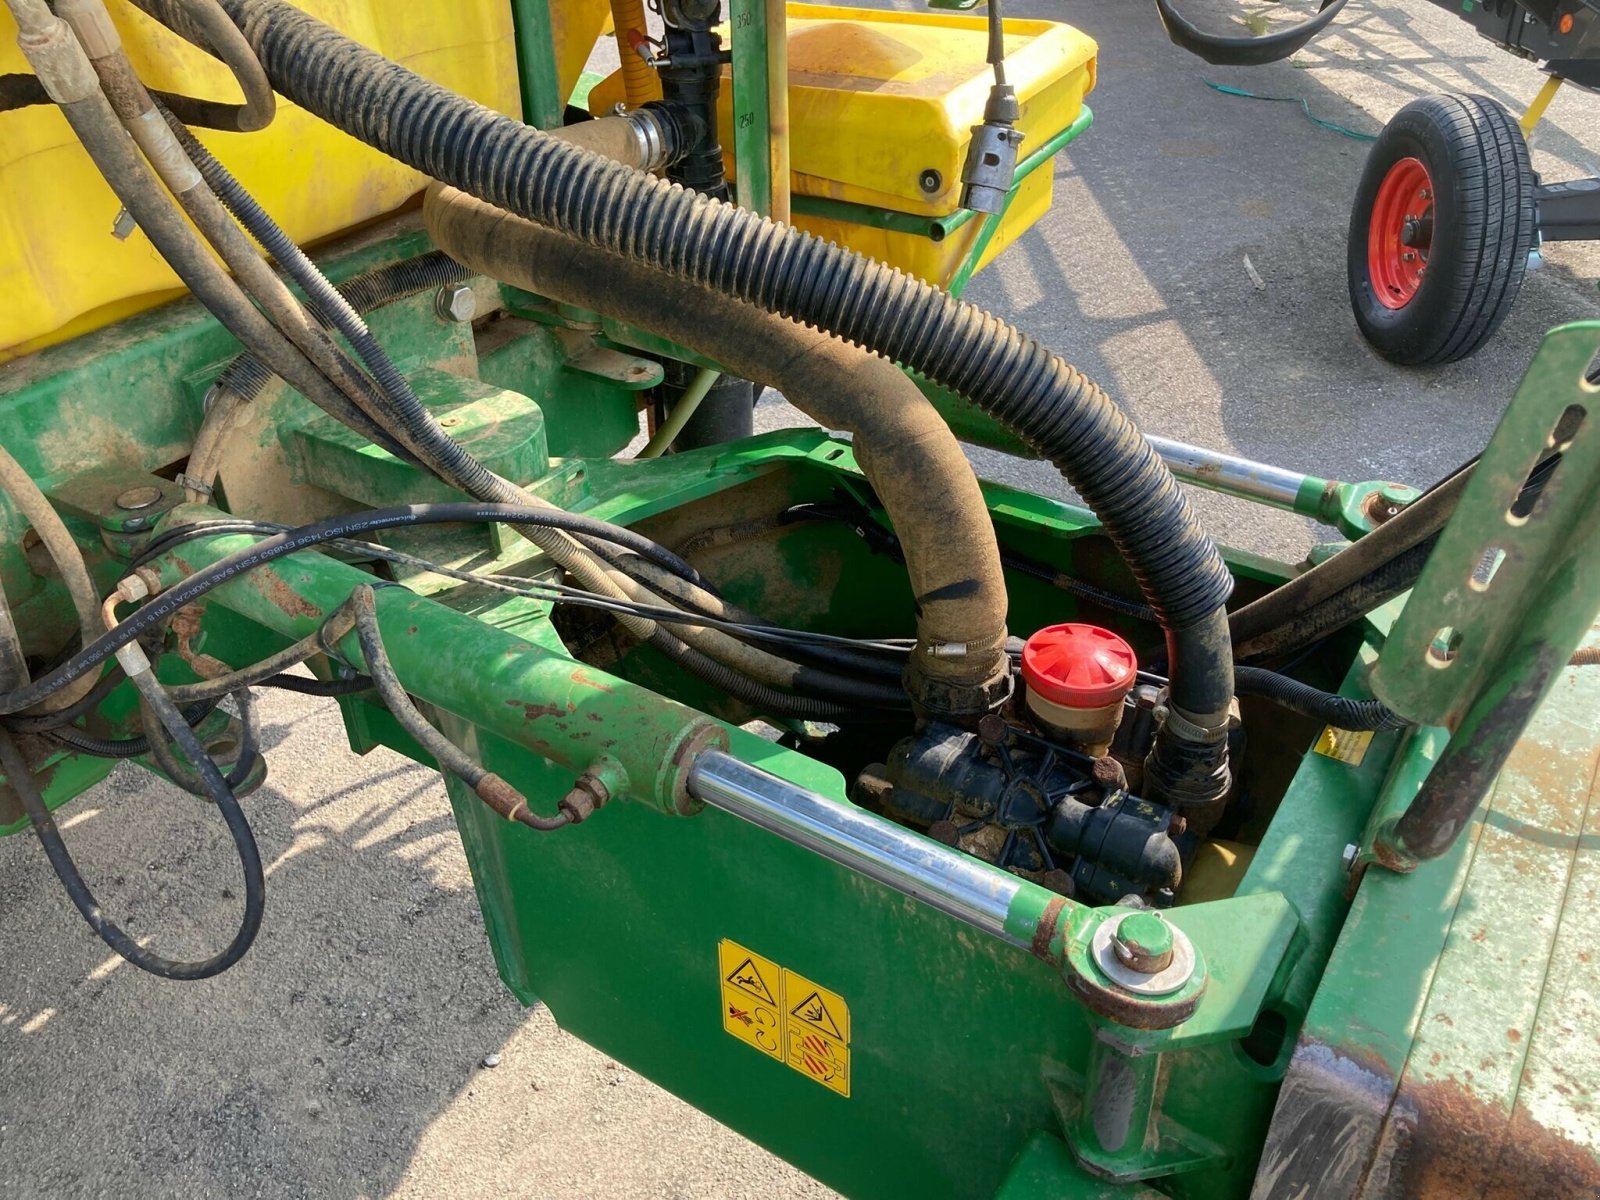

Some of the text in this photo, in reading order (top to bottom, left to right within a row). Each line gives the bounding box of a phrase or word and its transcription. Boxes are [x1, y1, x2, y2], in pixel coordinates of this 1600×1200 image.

[737, 12, 752, 29] 350
[739, 112, 754, 129] 250
[323, 526, 343, 536] ISO
[345, 521, 368, 531] 2SN
[297, 532, 321, 545] 1436
[260, 541, 296, 558] EN853
[235, 555, 258, 571] 2SN
[212, 568, 234, 583] SAE
[154, 604, 168, 617] DN
